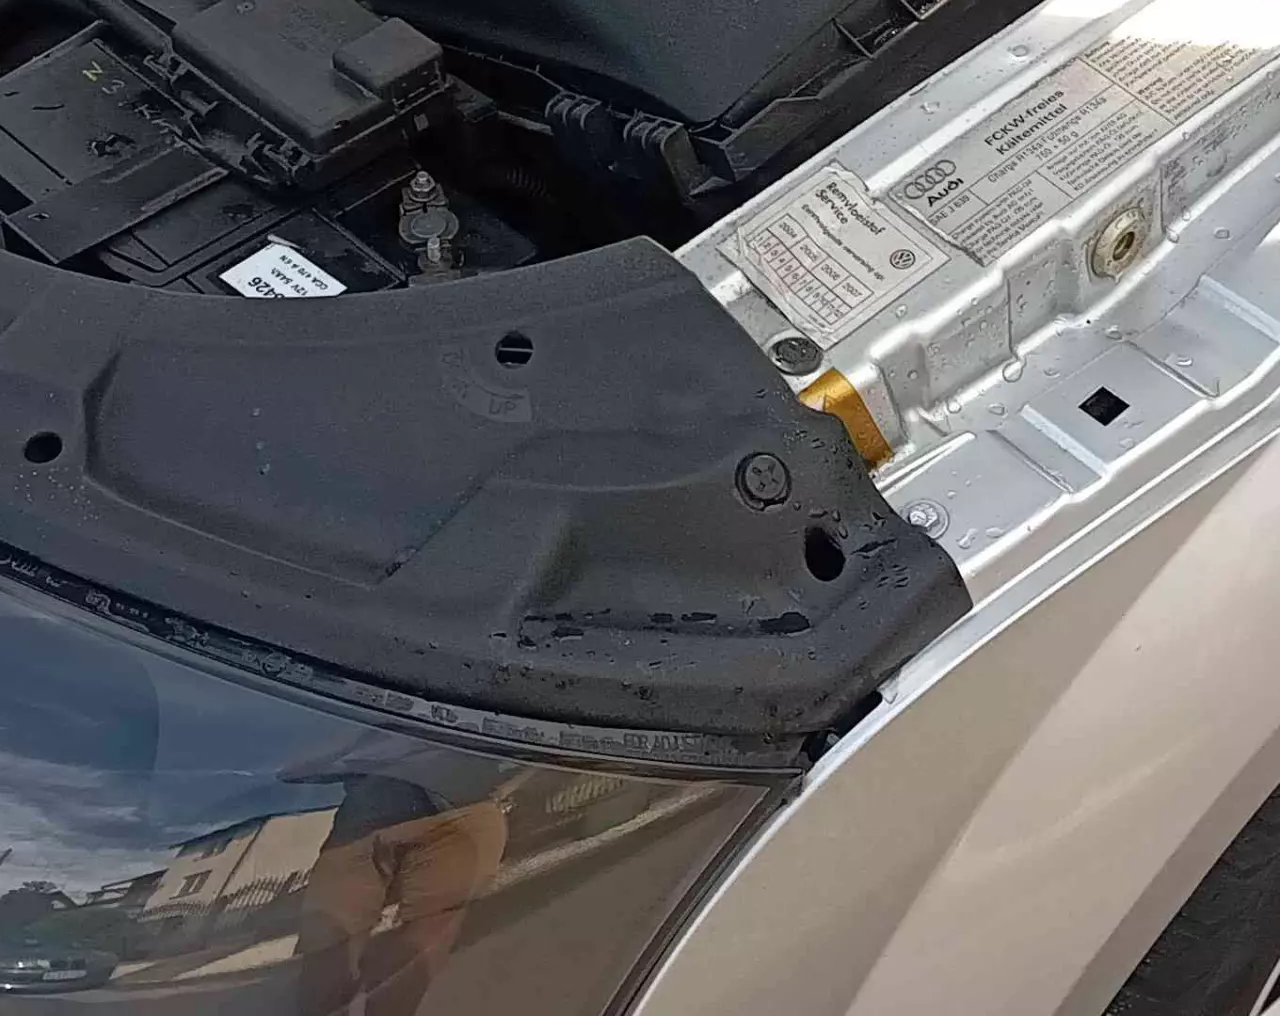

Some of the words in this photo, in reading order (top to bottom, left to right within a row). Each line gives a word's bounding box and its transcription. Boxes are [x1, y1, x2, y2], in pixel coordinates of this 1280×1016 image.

[985, 90, 1064, 147] FCKW-freies
[998, 104, 1067, 155] Kältemittel
[1057, 135, 1071, 144] 50
[815, 189, 848, 224] Service
[826, 182, 886, 235] Remvloeistof
[927, 178, 964, 207] Audi
[291, 283, 308, 296] 12V
